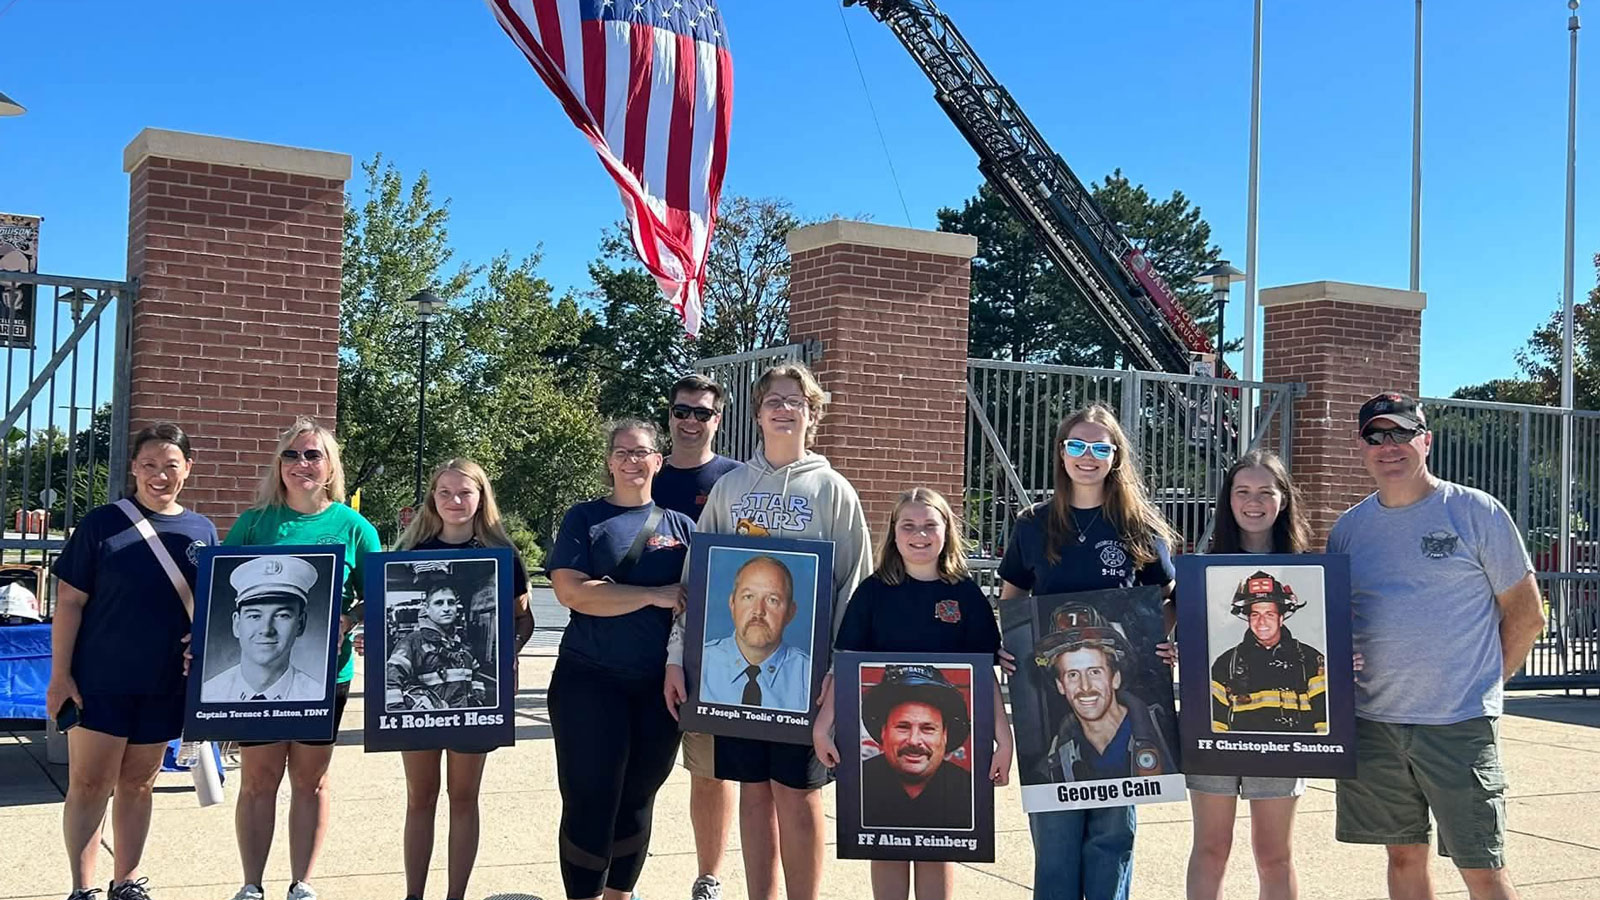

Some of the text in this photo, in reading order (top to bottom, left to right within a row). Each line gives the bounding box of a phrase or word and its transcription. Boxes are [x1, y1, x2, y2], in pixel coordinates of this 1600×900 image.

[1147, 267, 1201, 337] BALTIMORE
[1173, 315, 1200, 350] TRUCK
[731, 493, 813, 514] STAR
[731, 510, 812, 531] WARS
[196, 709, 329, 720] Captain Terence S. Hatton, FDNY
[379, 712, 504, 729] Lt Robert Hess
[697, 706, 809, 726] FF Joseph "Toolie" O'Toole
[1198, 740, 1344, 753] FF Christopher Santora
[1057, 779, 1161, 802] George Cain
[858, 833, 978, 851] FF Alan Feinberg
